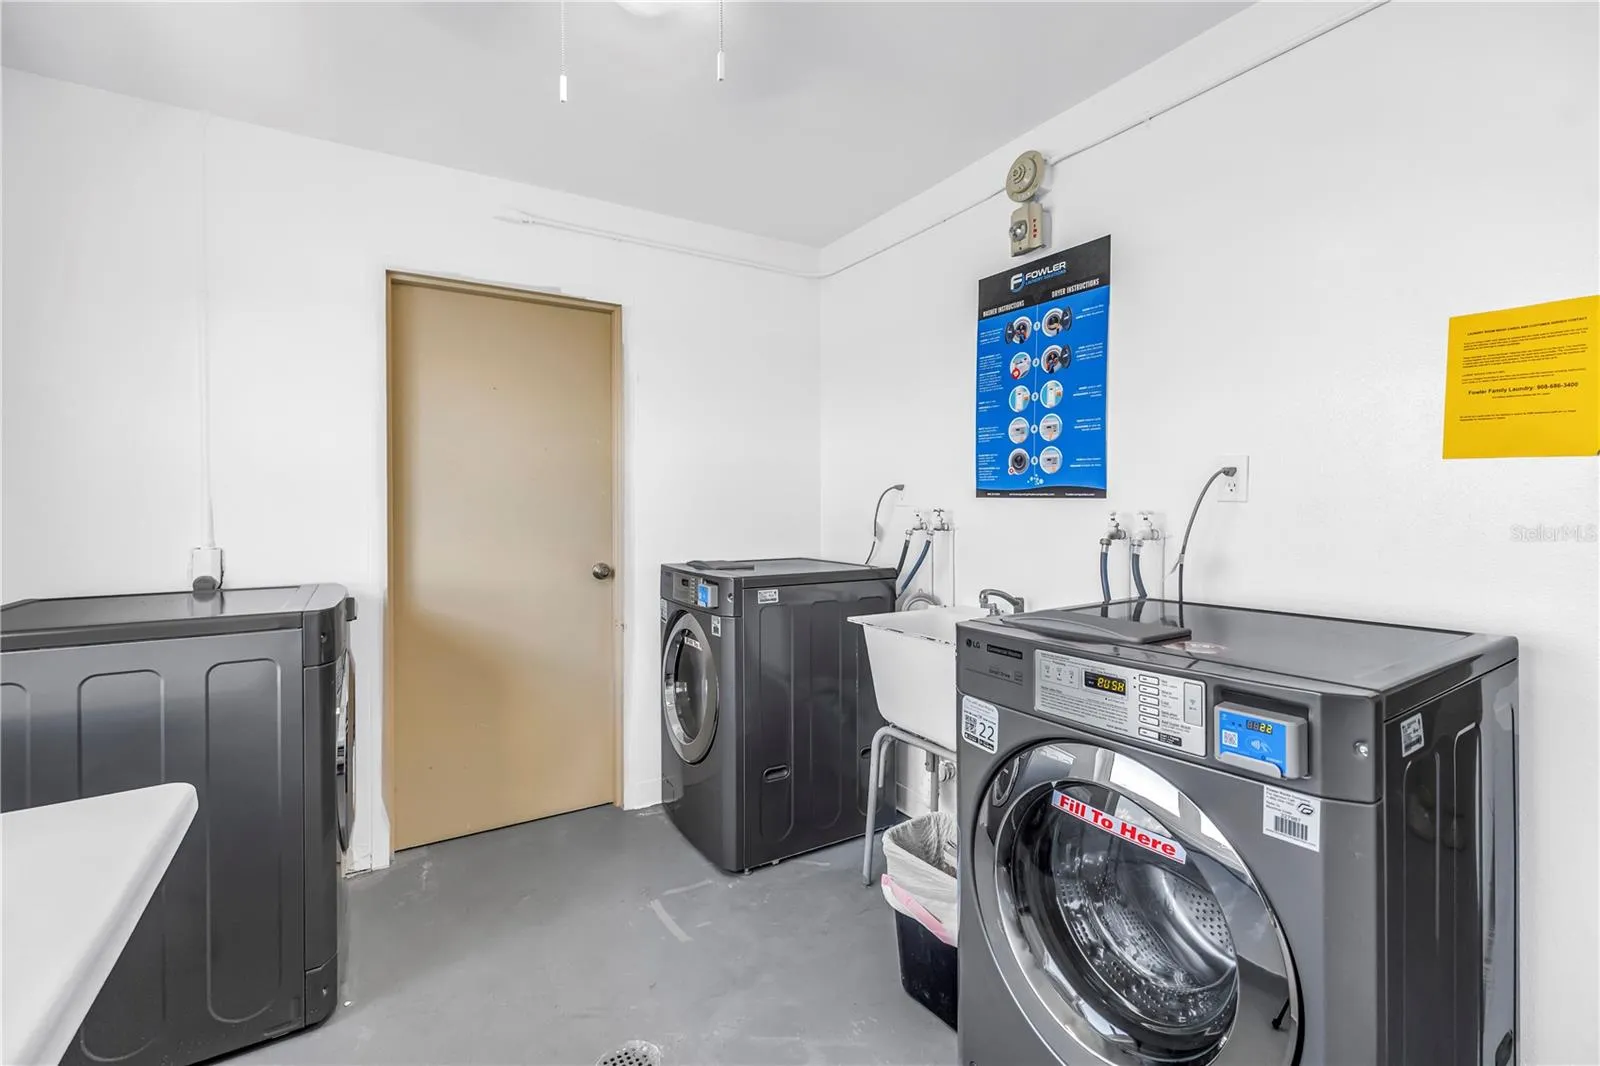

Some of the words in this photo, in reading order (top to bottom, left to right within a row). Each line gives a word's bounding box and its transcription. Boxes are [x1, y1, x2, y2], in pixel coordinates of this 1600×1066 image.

[1025, 261, 1067, 281] FOWLER
[1051, 287, 1066, 298] DRYER
[1066, 278, 1100, 294] INSTRUCTIONS
[998, 299, 1025, 313] INSTRUCTIONS
[972, 641, 981, 649] LG
[1097, 677, 1125, 692] PUSH
[979, 722, 995, 743] 22
[1059, 794, 1086, 817] Fill
[1091, 808, 1114, 830] To
[1120, 821, 1176, 856] Here
